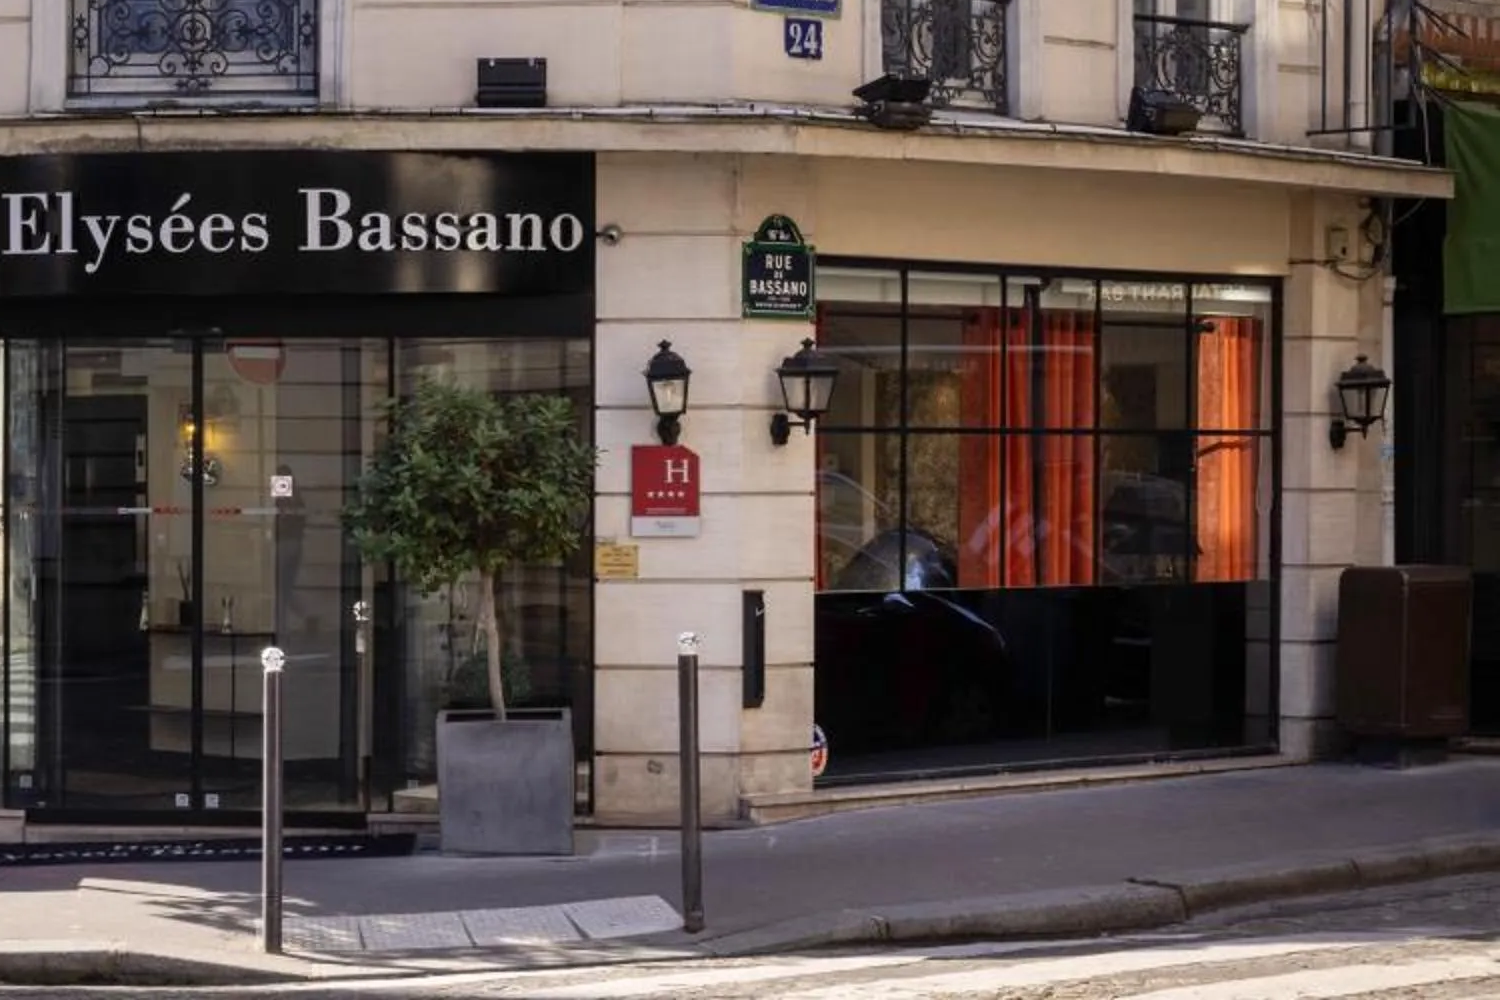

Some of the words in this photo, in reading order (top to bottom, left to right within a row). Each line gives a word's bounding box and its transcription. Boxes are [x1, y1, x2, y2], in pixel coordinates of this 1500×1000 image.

[789, 23, 818, 54] 24
[1, 191, 269, 272] Elysées
[298, 187, 584, 252] Bassano
[765, 254, 792, 270] RUE
[749, 280, 807, 297] BASSANO
[664, 459, 690, 483] H
